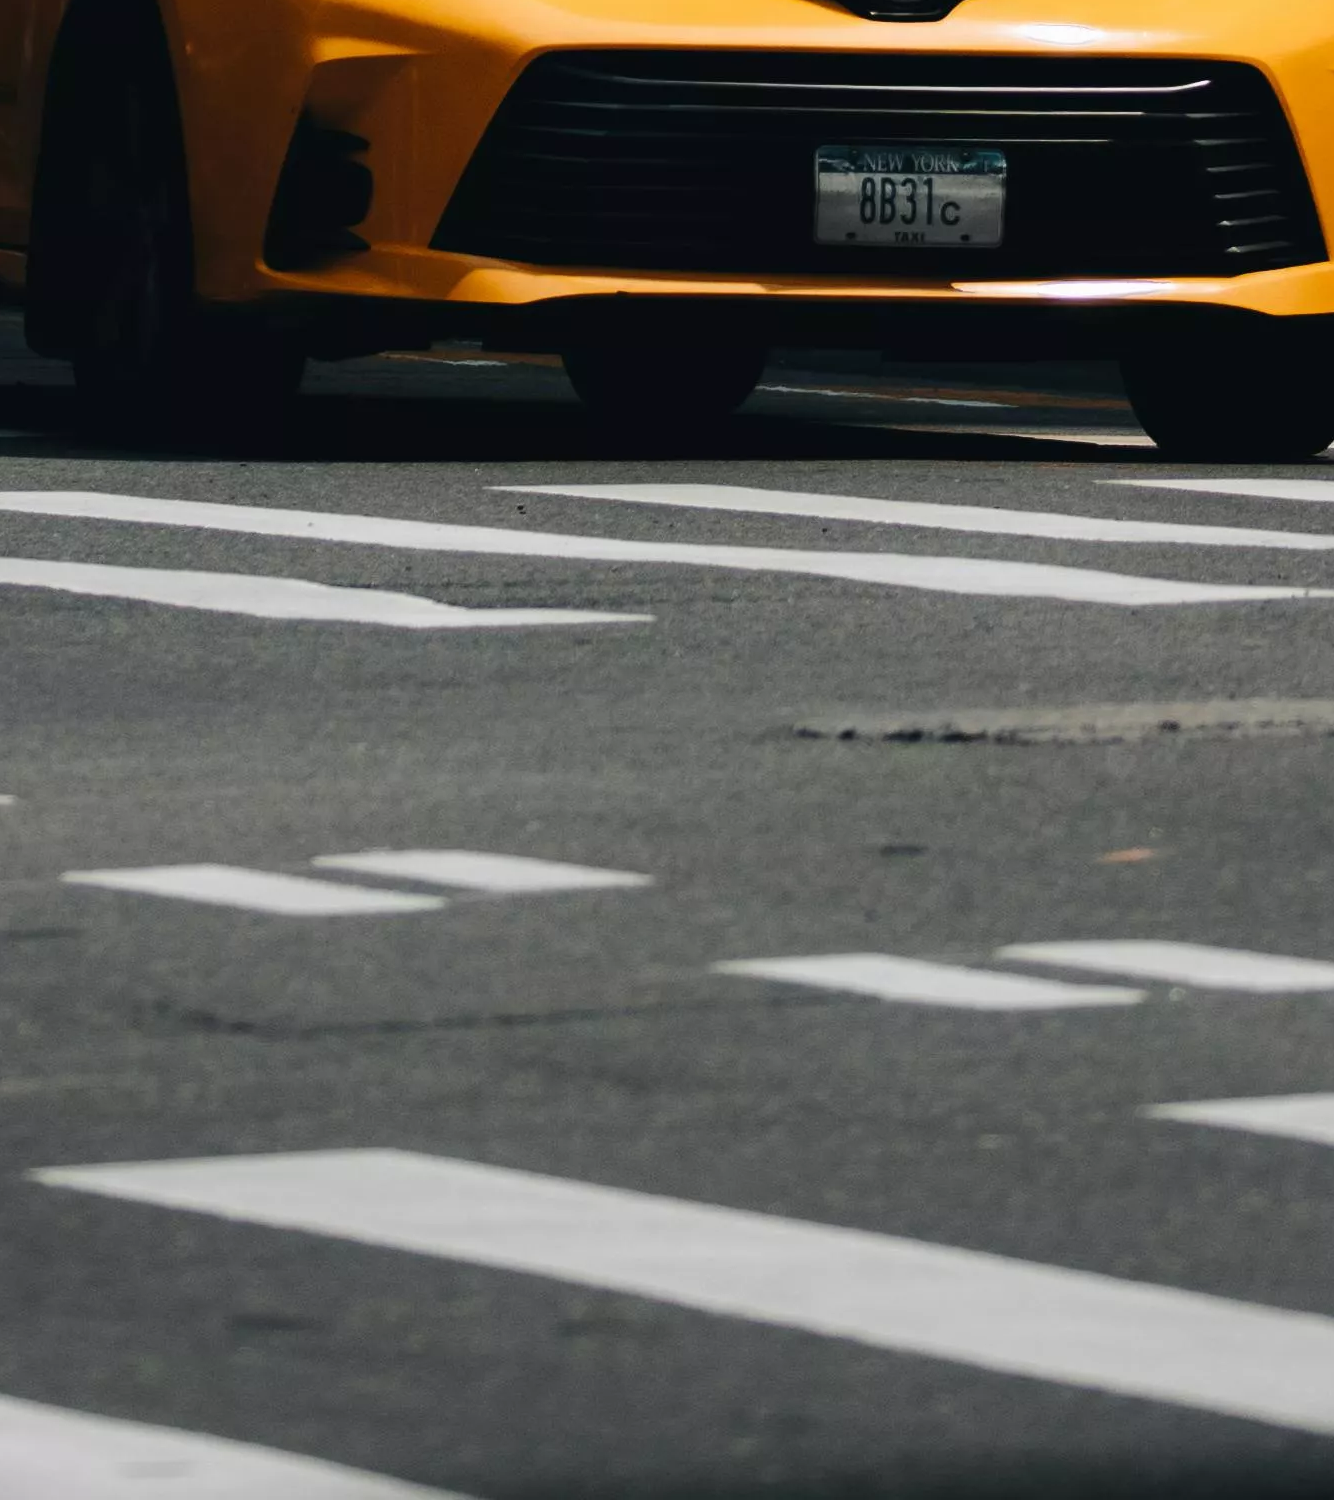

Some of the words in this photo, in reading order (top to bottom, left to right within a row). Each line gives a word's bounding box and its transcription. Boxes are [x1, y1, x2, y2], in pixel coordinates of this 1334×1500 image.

[862, 152, 905, 173] NEW
[911, 152, 960, 173] YORK
[894, 231, 926, 244] TAXI
